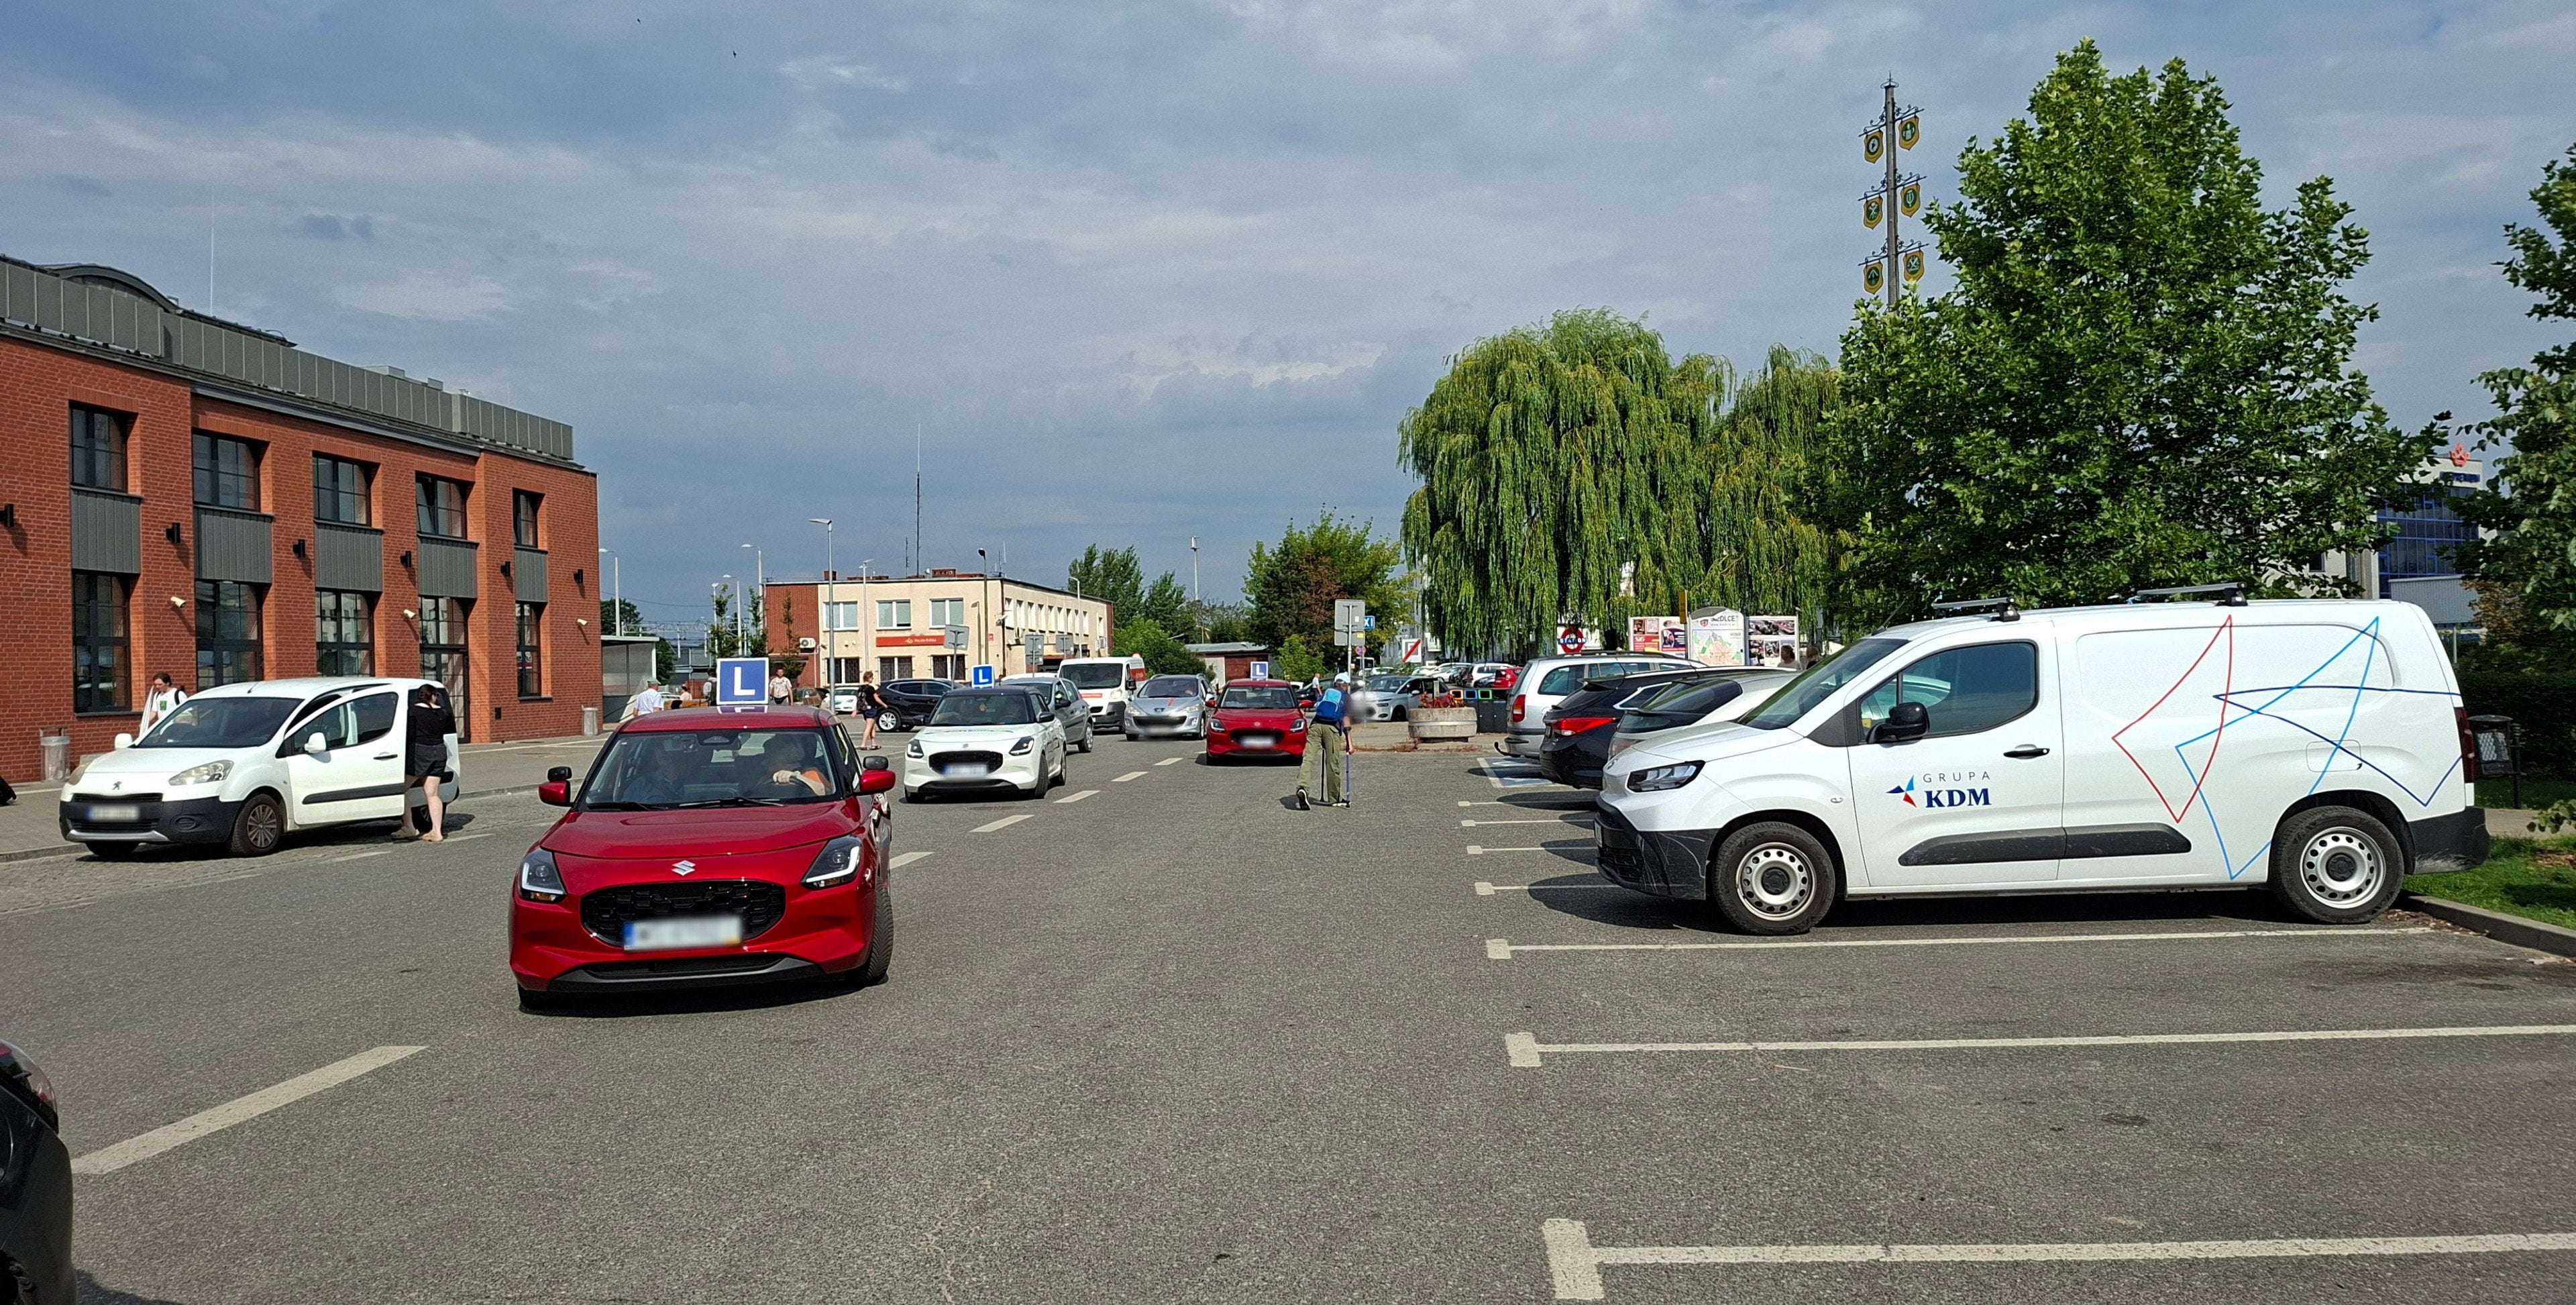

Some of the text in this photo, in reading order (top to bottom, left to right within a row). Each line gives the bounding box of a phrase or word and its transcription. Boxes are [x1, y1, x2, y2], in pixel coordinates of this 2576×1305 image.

[979, 669, 989, 683] L
[1256, 664, 1265, 676] L
[734, 666, 755, 696] L
[1923, 771, 1990, 783] GRUPA
[1924, 788, 1992, 808] KDM
